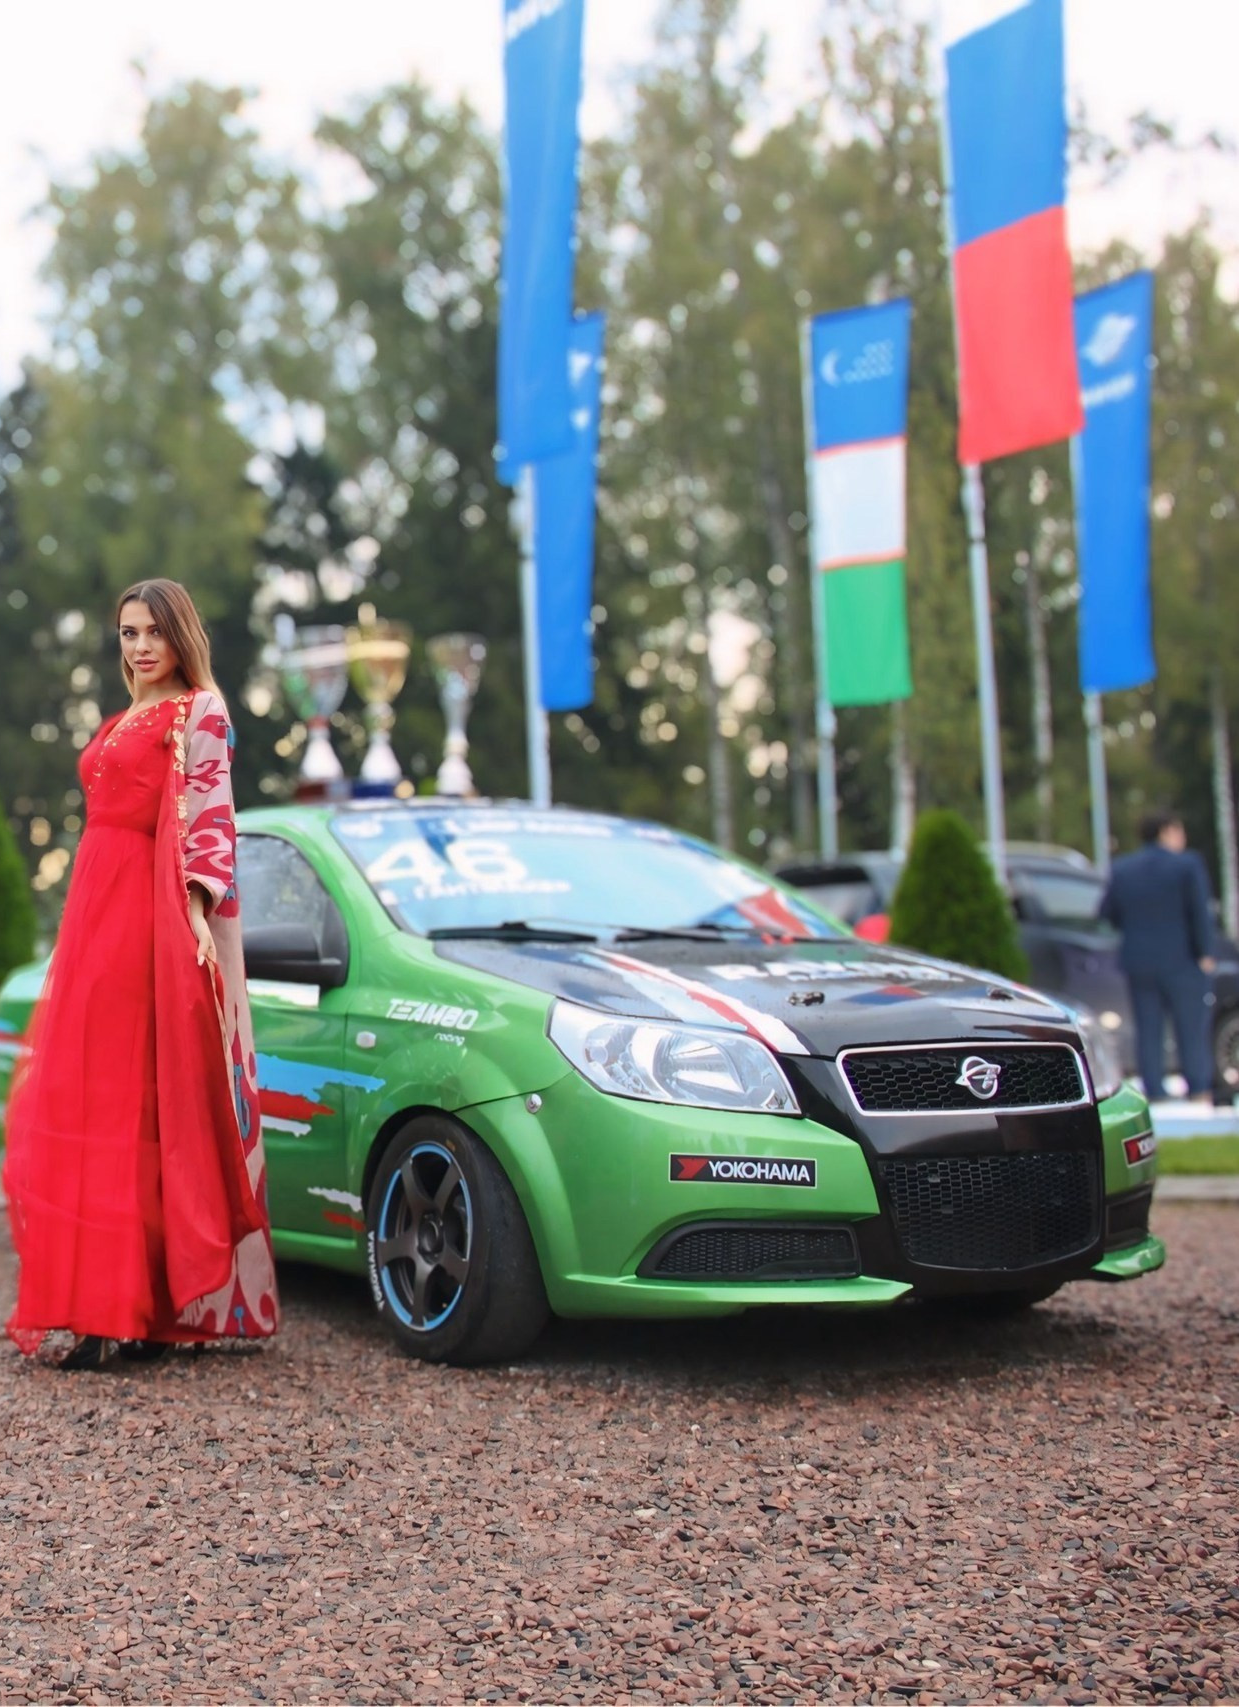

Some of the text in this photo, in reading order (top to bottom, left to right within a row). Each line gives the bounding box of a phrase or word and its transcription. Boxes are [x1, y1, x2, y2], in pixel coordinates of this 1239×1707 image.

[366, 839, 528, 884] 46
[386, 998, 479, 1030] TEAMBO
[709, 1160, 811, 1183] YOKOHAMA
[367, 1230, 385, 1311] YOKOHAMA
